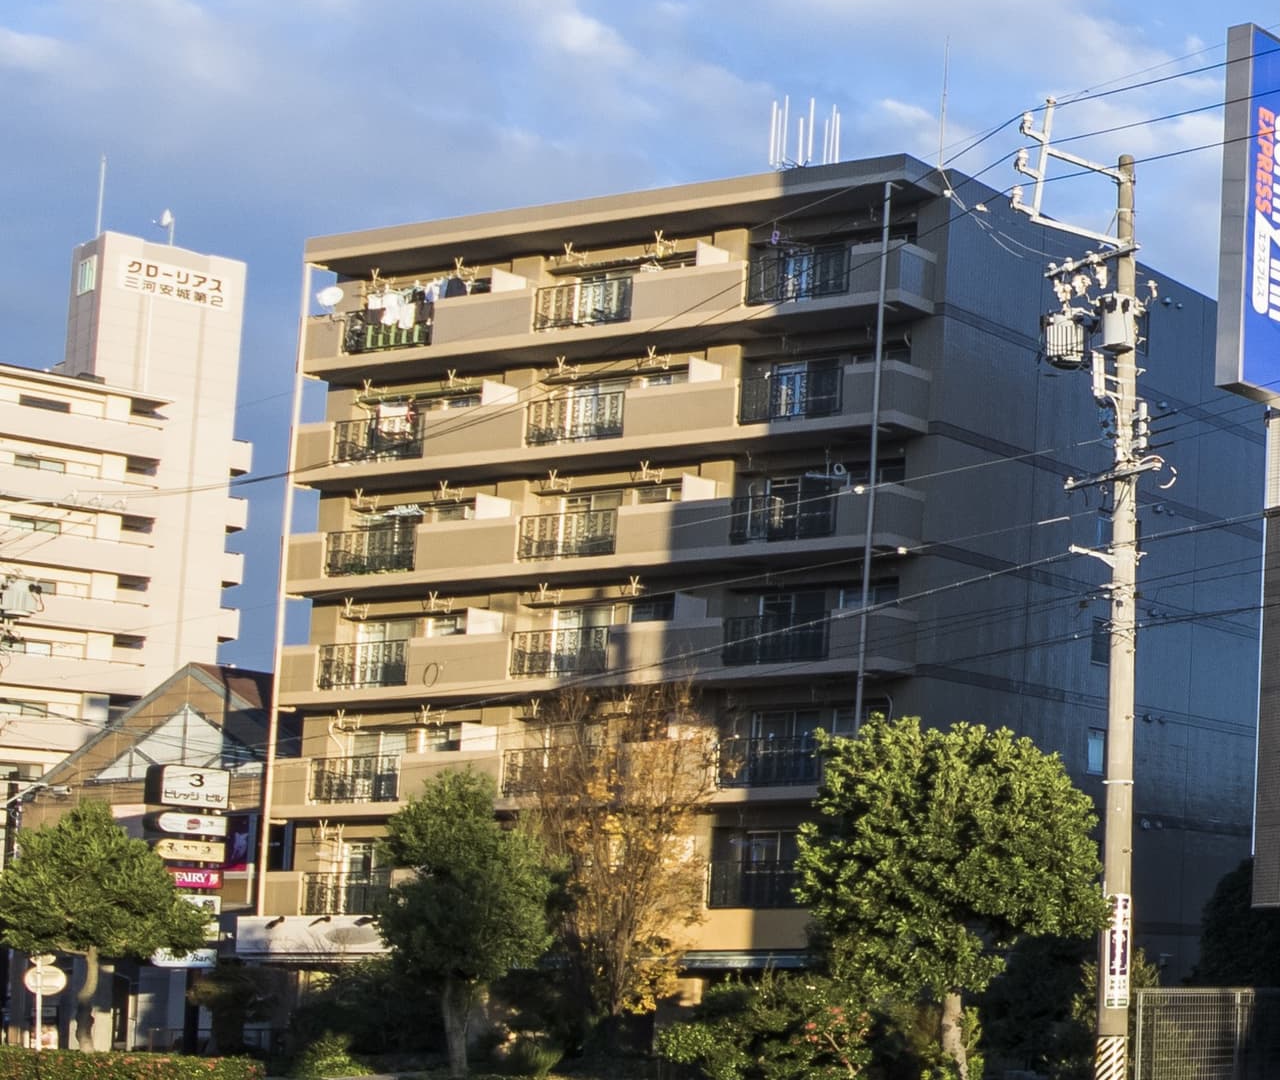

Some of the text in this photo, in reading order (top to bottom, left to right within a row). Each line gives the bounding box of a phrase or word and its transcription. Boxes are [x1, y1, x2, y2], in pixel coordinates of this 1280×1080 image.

[1255, 106, 1275, 216] EXPRESS
[128, 260, 222, 293] クローリアス
[189, 773, 204, 787] 3
[175, 871, 207, 883] FAIRY
